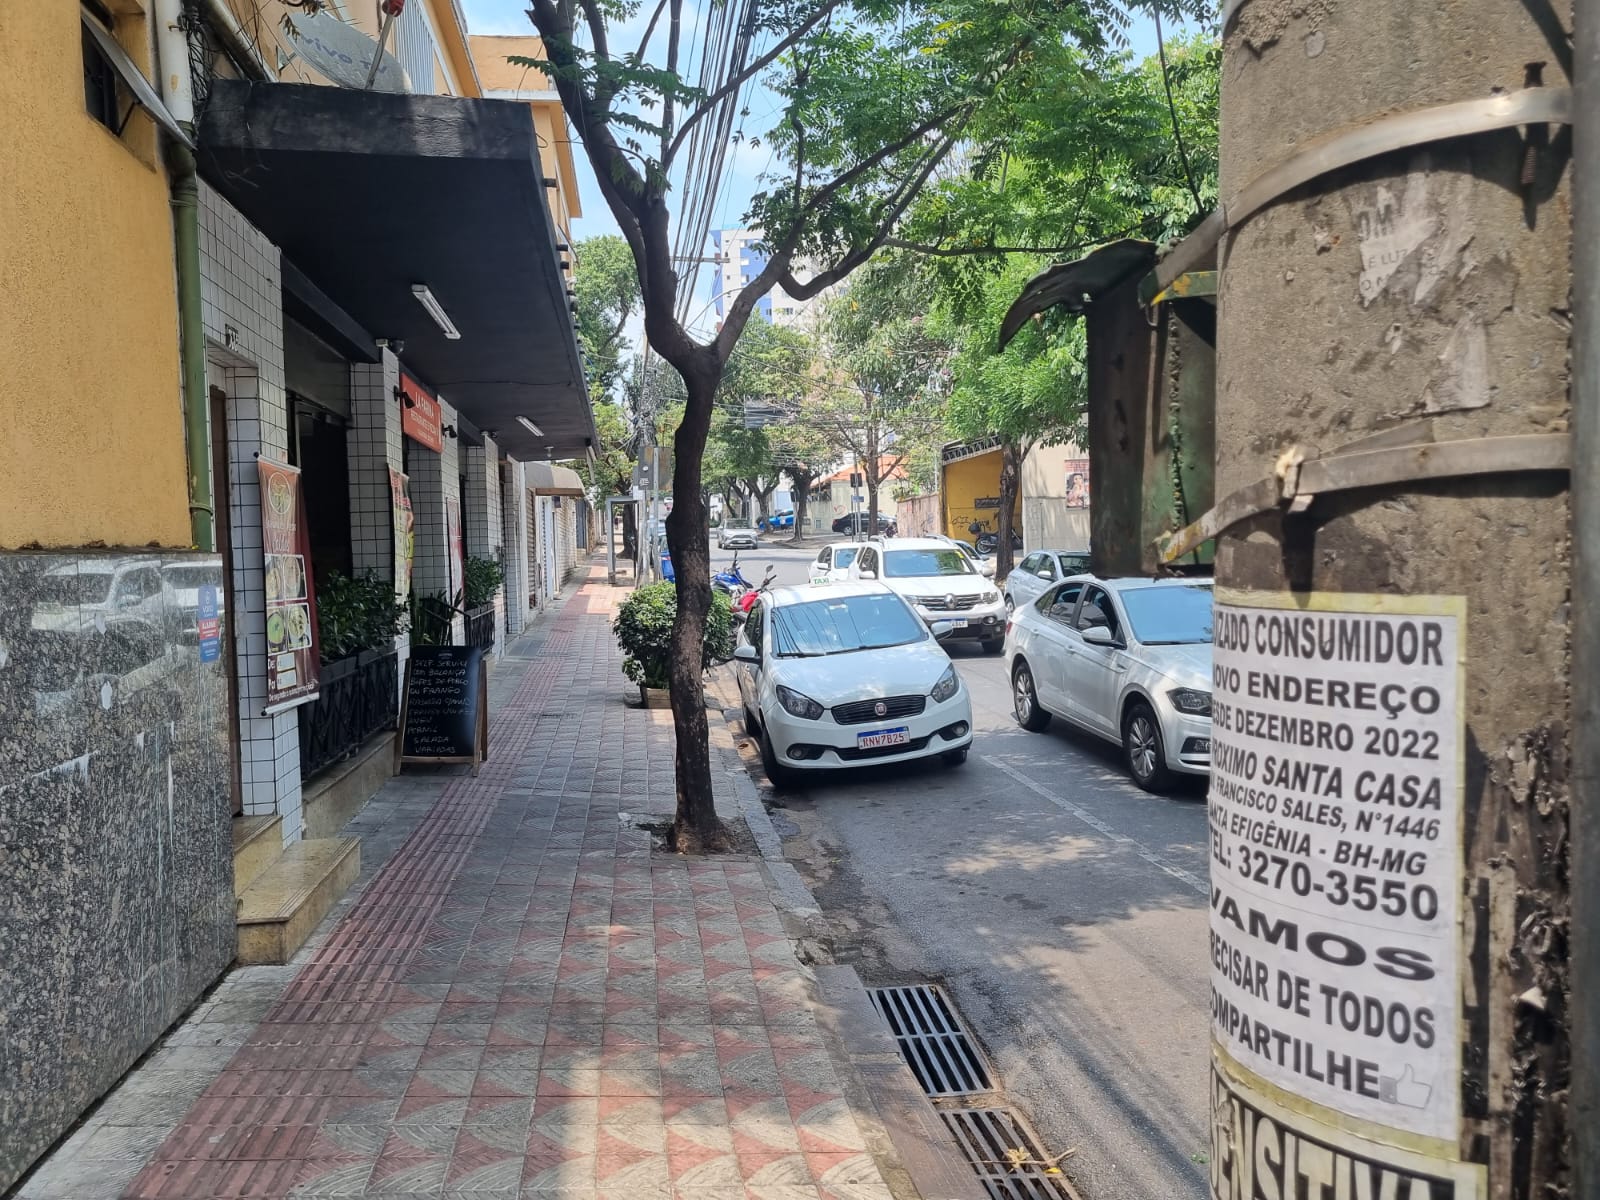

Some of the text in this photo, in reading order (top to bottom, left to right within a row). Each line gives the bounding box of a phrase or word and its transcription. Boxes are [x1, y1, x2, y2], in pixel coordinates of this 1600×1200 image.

[1254, 614, 1444, 667] CONSUMIDOR
[1247, 670, 1441, 720] ENDEREÇO
[1235, 707, 1354, 752] DEZEMBRO
[1364, 725, 1440, 760] 2022
[1216, 775, 1278, 814] FRANCISCO
[1281, 797, 1347, 834] SALES,
[1262, 754, 1343, 799] SANTA
[1354, 769, 1441, 811] CASA
[1230, 812, 1311, 858] EFIGÊNIA
[1332, 839, 1428, 876] BH-MG
[1238, 845, 1439, 921] 3270-3550
[1209, 880, 1436, 981] VAMOS
[1276, 968, 1311, 1018] DE
[1319, 983, 1436, 1050] TODOS
